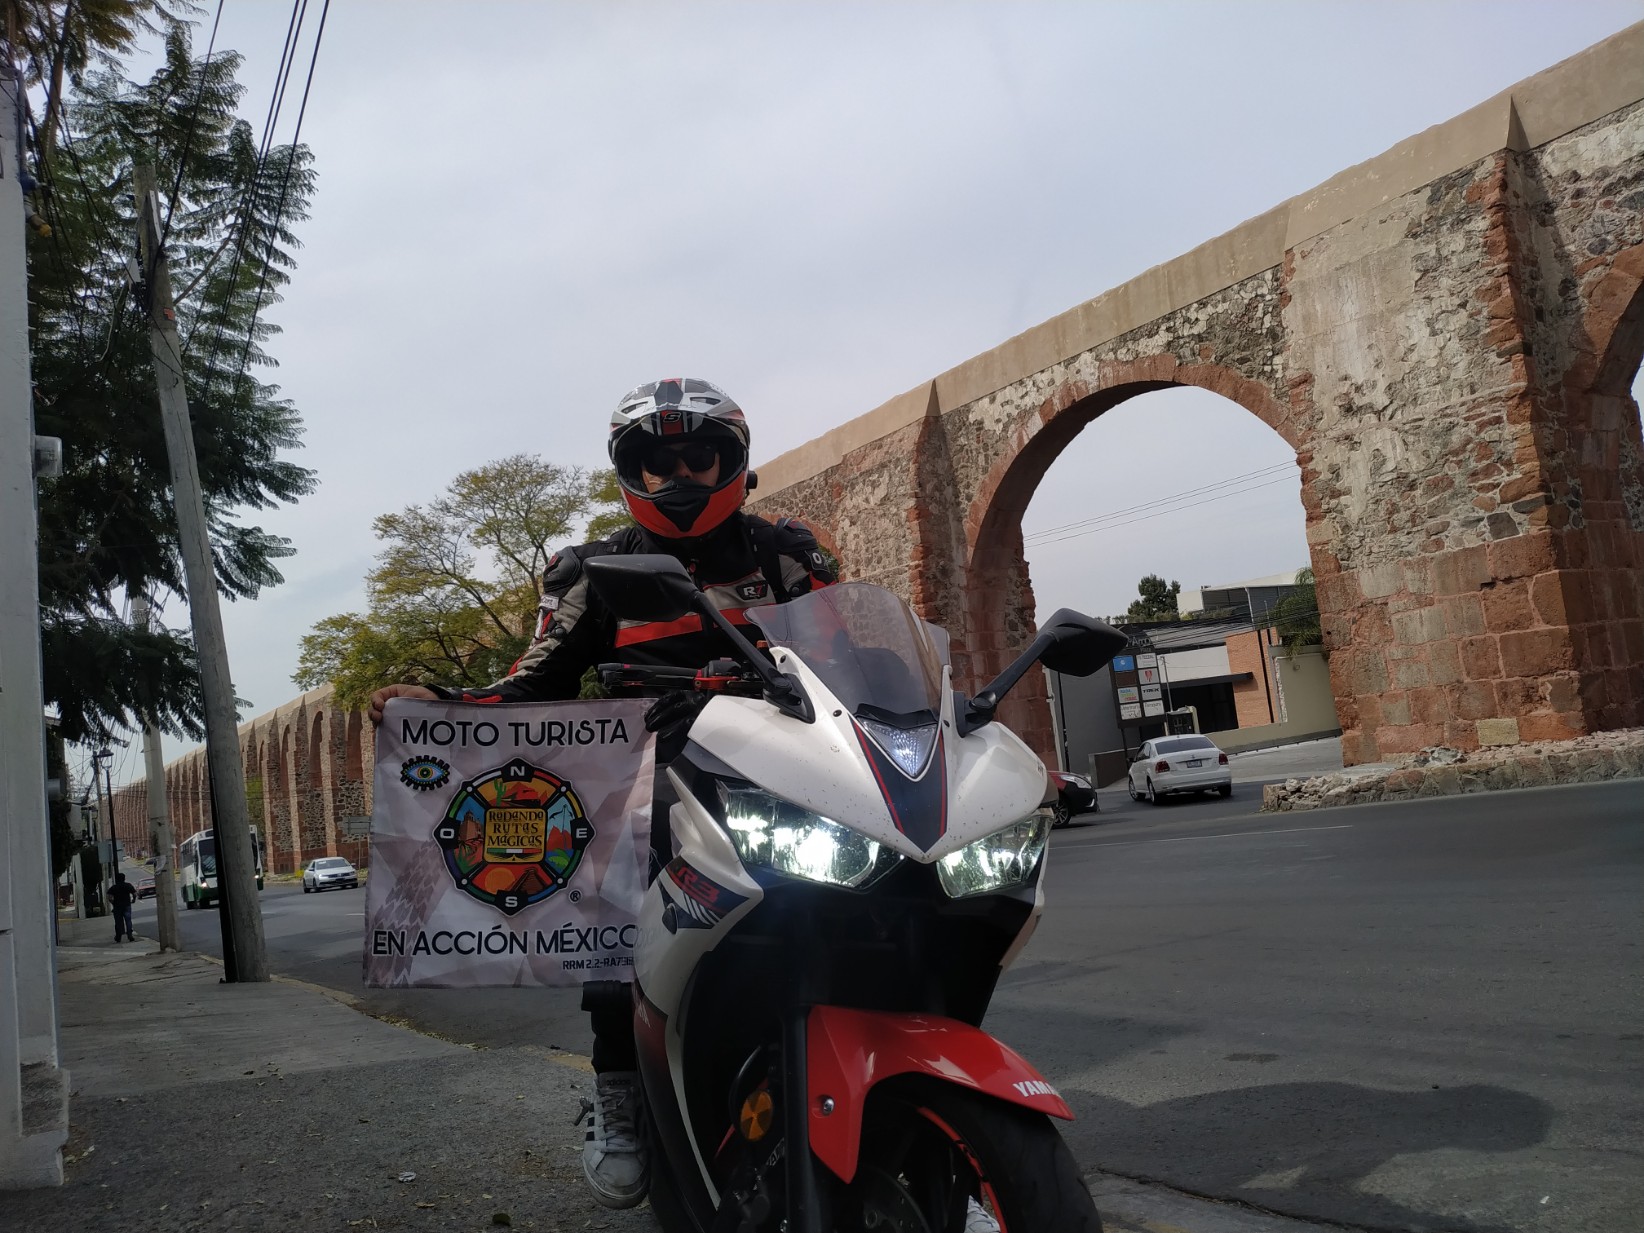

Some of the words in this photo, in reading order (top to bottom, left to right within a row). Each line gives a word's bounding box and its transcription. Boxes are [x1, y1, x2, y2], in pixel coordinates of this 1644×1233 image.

[402, 718, 499, 746] MOTO
[508, 718, 629, 746] TURISTA
[510, 766, 525, 776] N
[576, 827, 588, 839] E
[676, 866, 720, 903] R3
[505, 896, 518, 908] S
[373, 930, 405, 955] EN
[412, 924, 527, 955] ACCIÓN
[536, 922, 635, 954] MÉXICO
[562, 959, 585, 970] RRM
